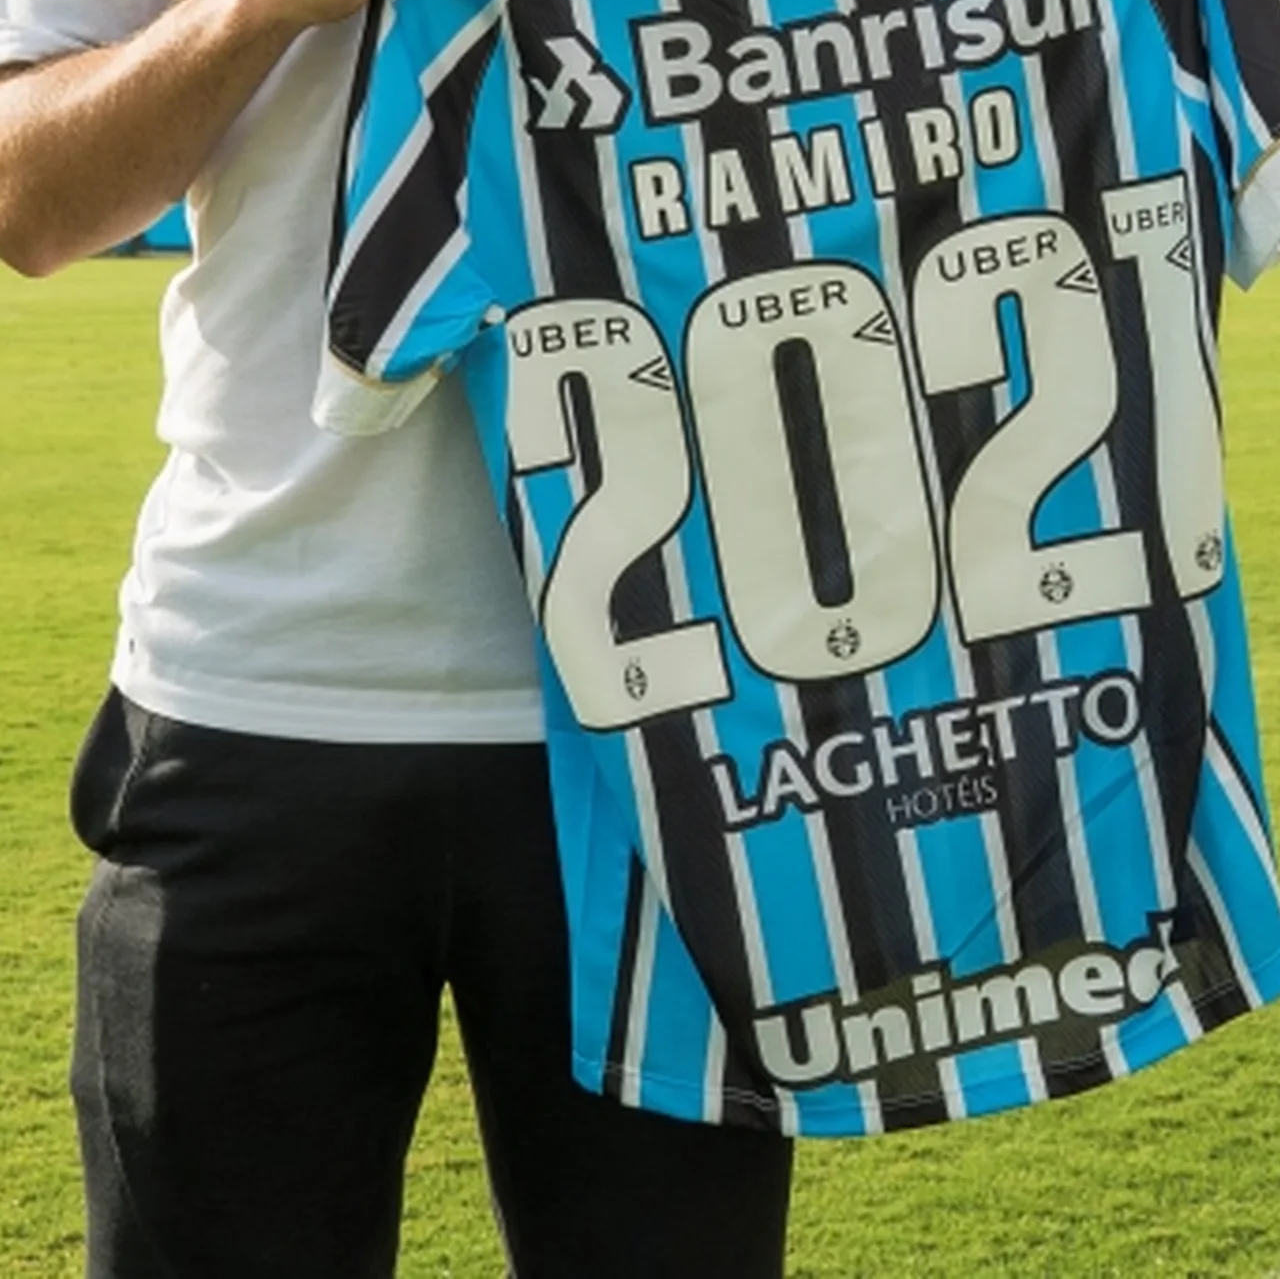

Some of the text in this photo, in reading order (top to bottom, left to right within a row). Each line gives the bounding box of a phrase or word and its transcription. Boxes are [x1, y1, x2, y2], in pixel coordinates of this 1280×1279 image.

[631, 87, 1020, 239] RAMIRO
[1111, 201, 1185, 235] UBER
[937, 228, 1058, 283] UBER
[719, 280, 848, 328] UBER
[510, 317, 632, 358] UBER
[504, 172, 1225, 729] 2021
[711, 678, 1140, 824] LAGHETTO
[886, 775, 998, 823] HOTÉIS
